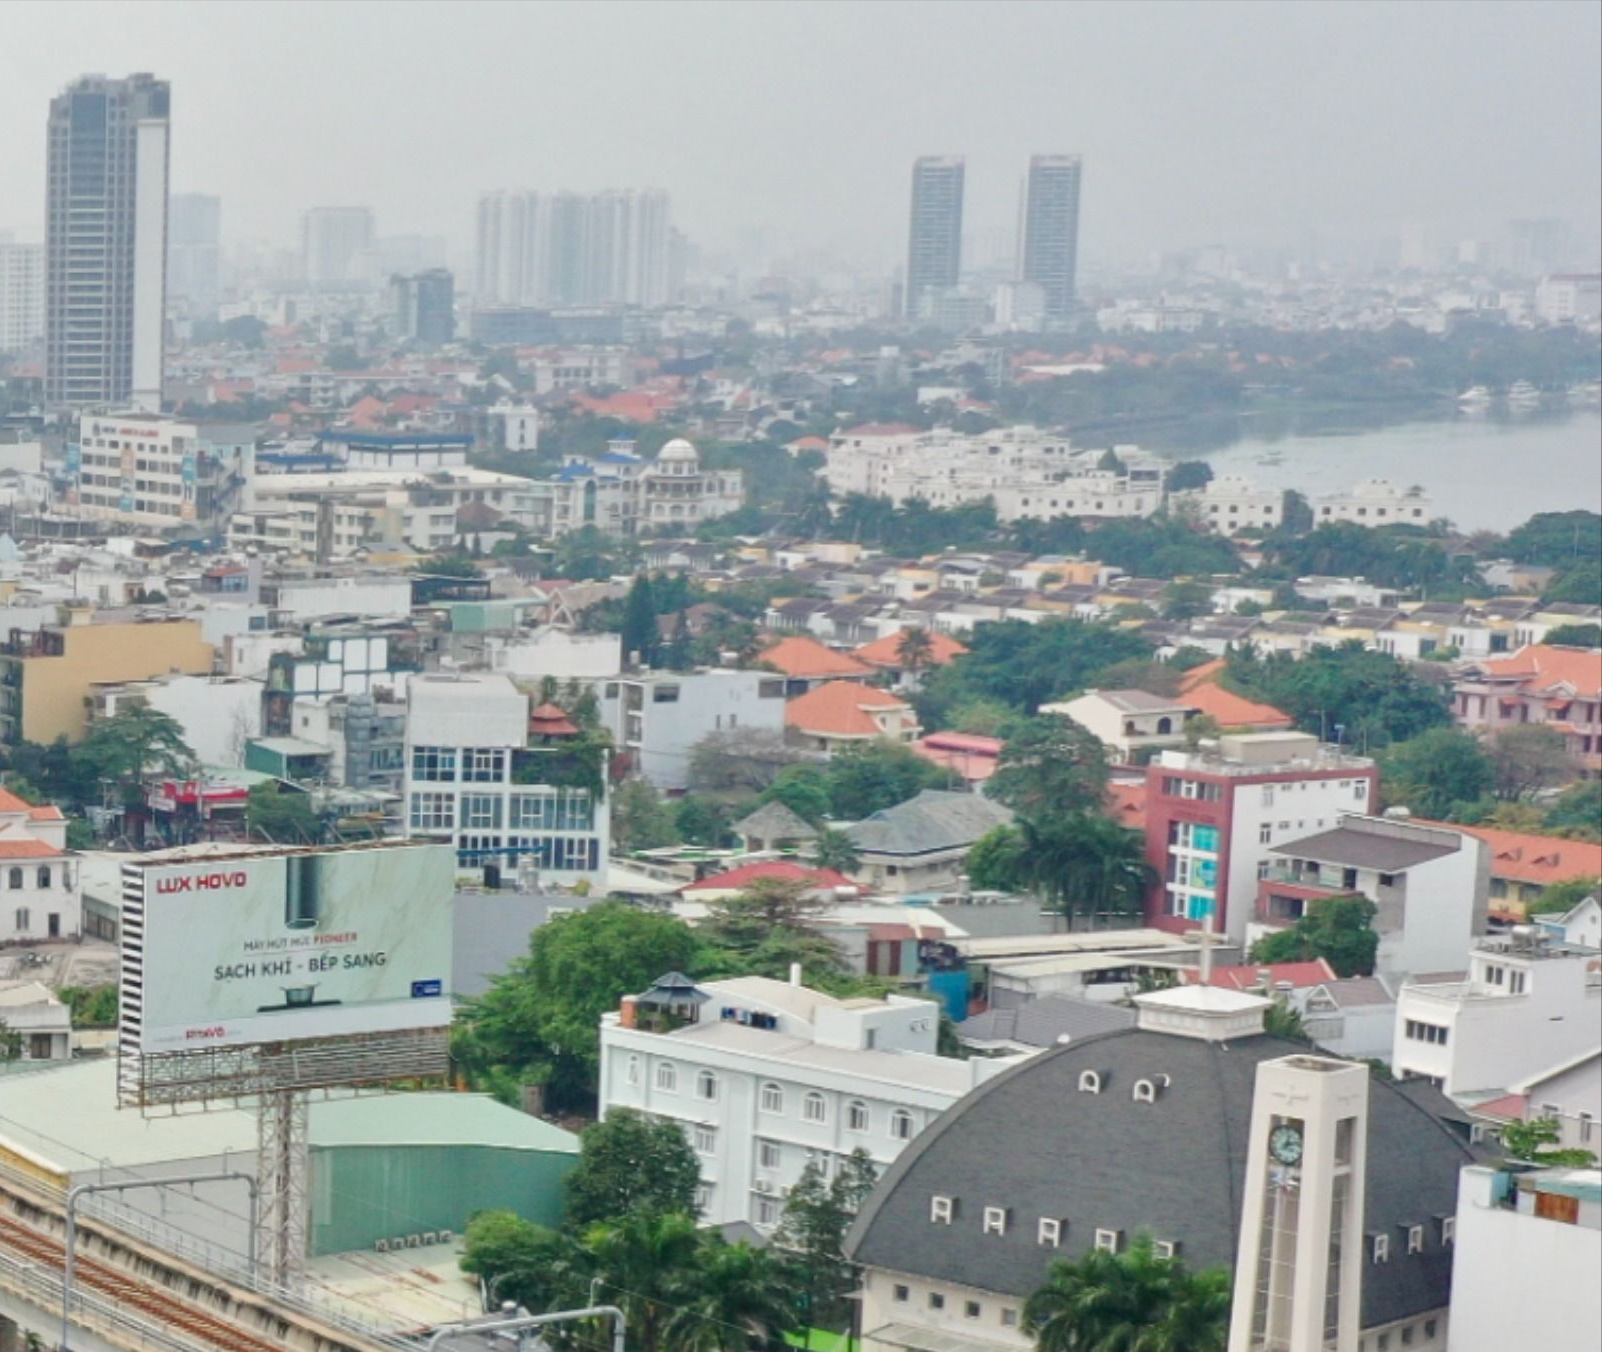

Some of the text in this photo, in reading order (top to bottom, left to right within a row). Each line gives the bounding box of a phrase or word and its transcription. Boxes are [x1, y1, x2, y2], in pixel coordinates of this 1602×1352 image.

[156, 875, 192, 894] LUX
[214, 963, 256, 984] SẠCH
[342, 951, 387, 969] SANG
